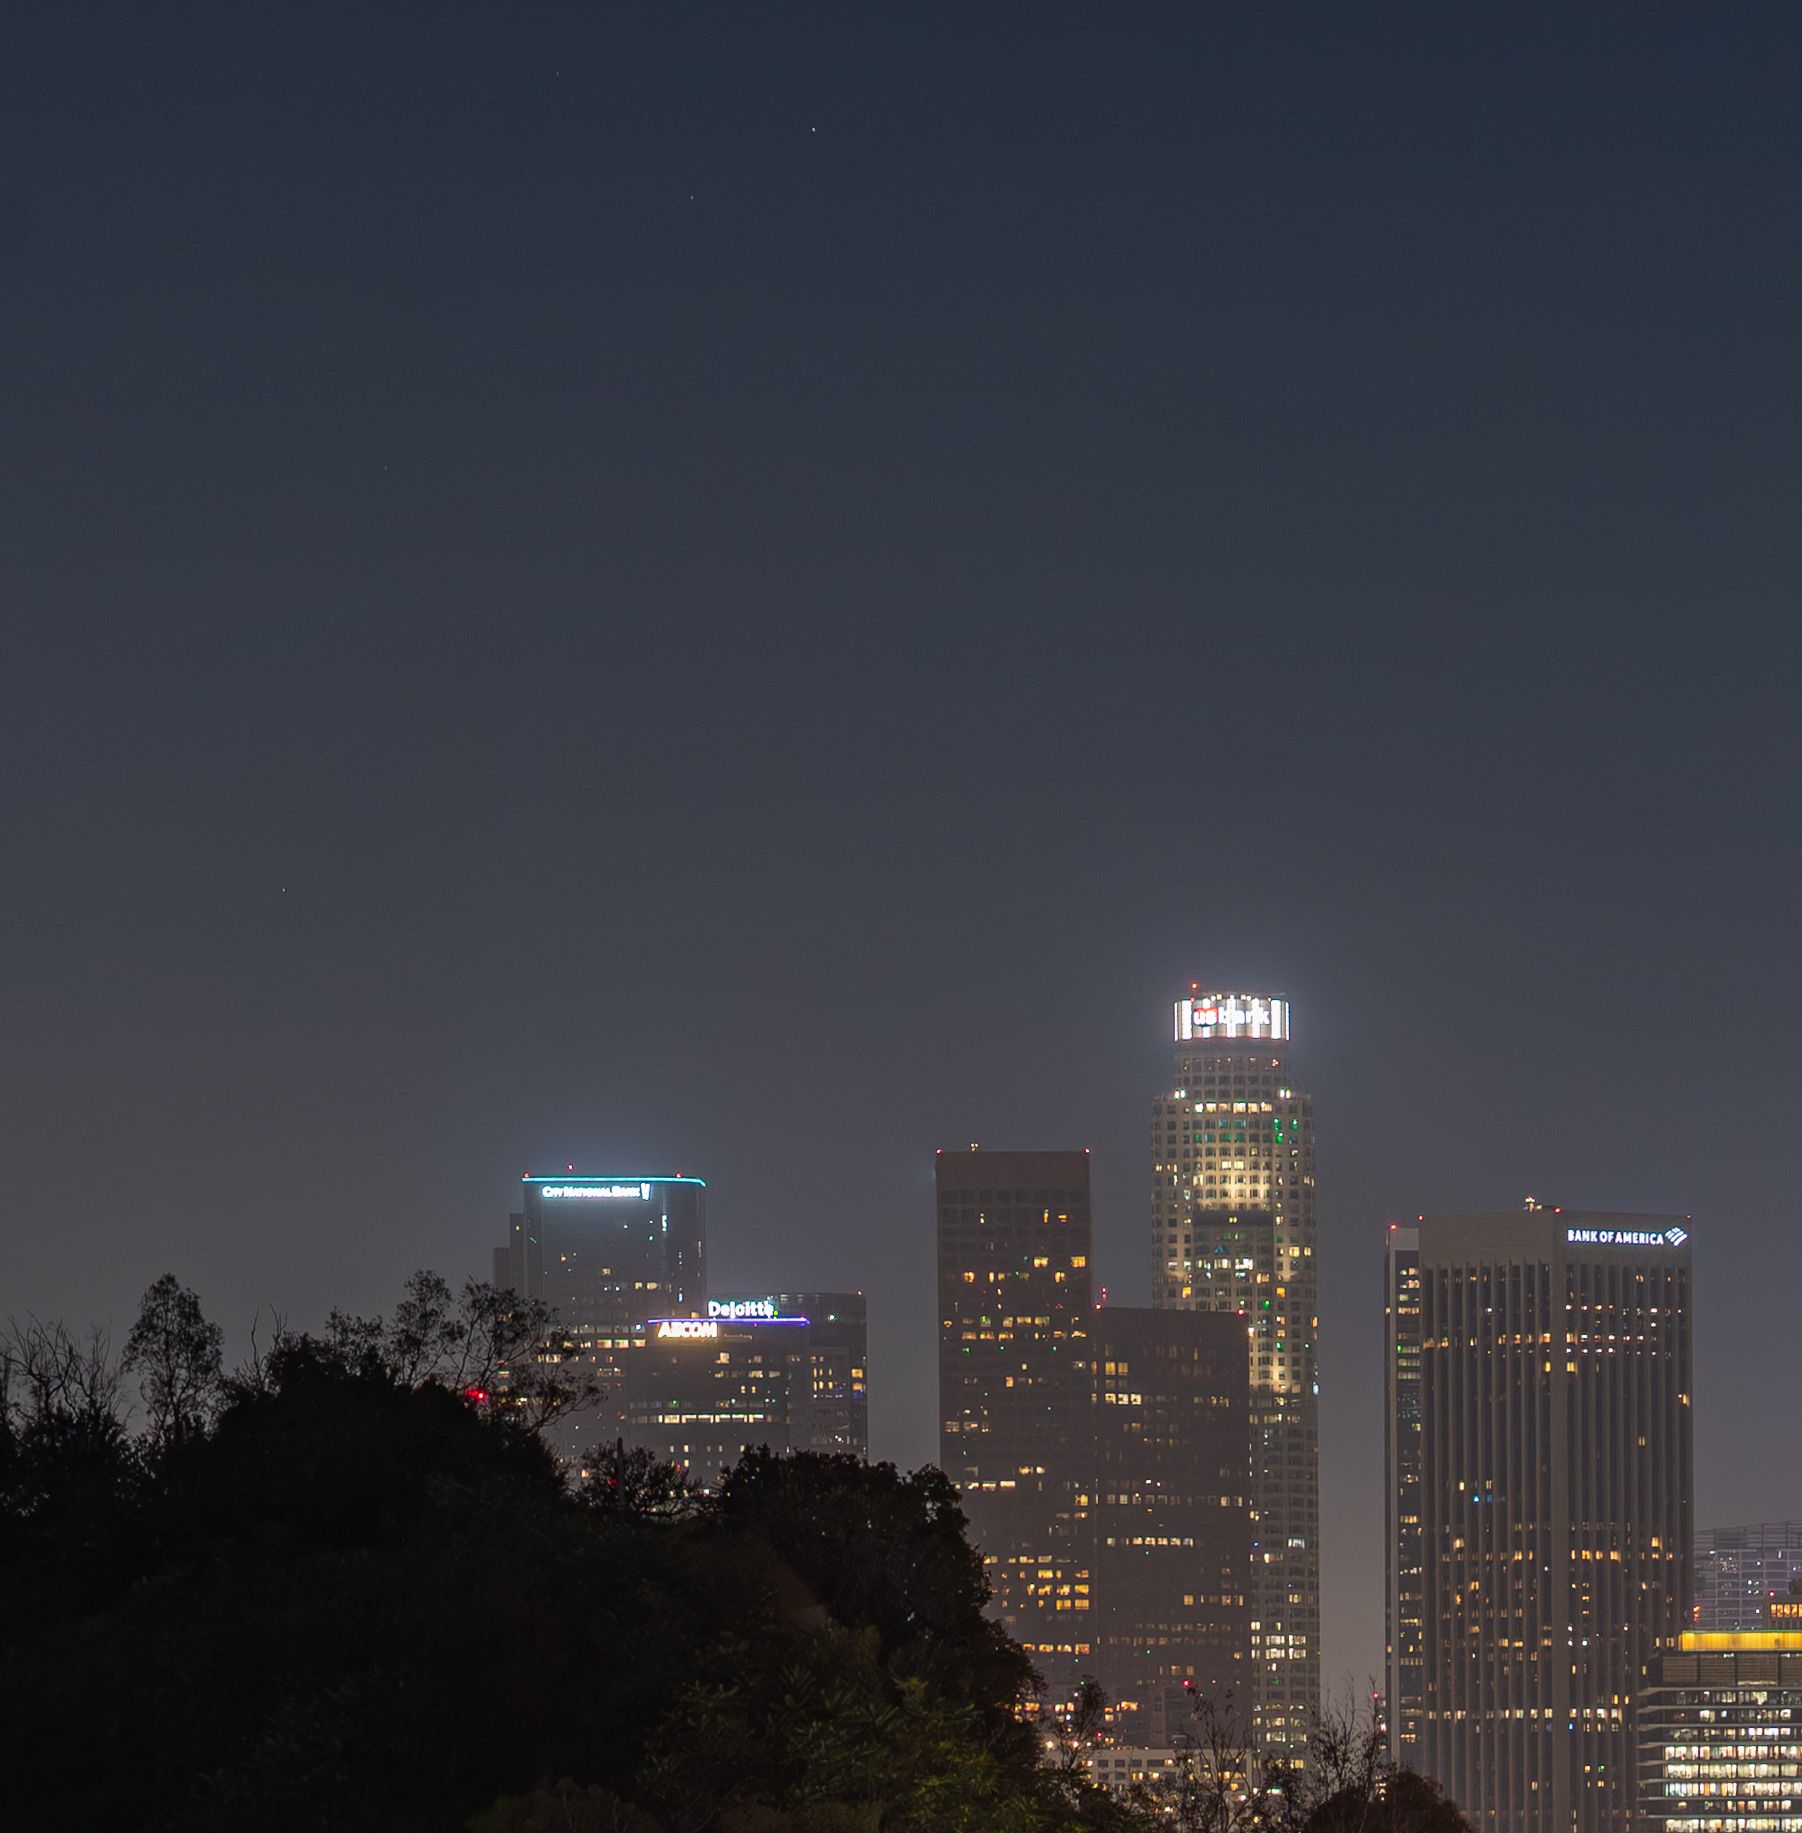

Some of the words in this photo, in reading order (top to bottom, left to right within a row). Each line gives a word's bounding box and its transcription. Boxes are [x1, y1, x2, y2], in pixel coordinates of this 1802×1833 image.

[1567, 1229, 1598, 1242] BANK
[1599, 1231, 1614, 1243] OF
[1615, 1232, 1664, 1245] AMERICA
